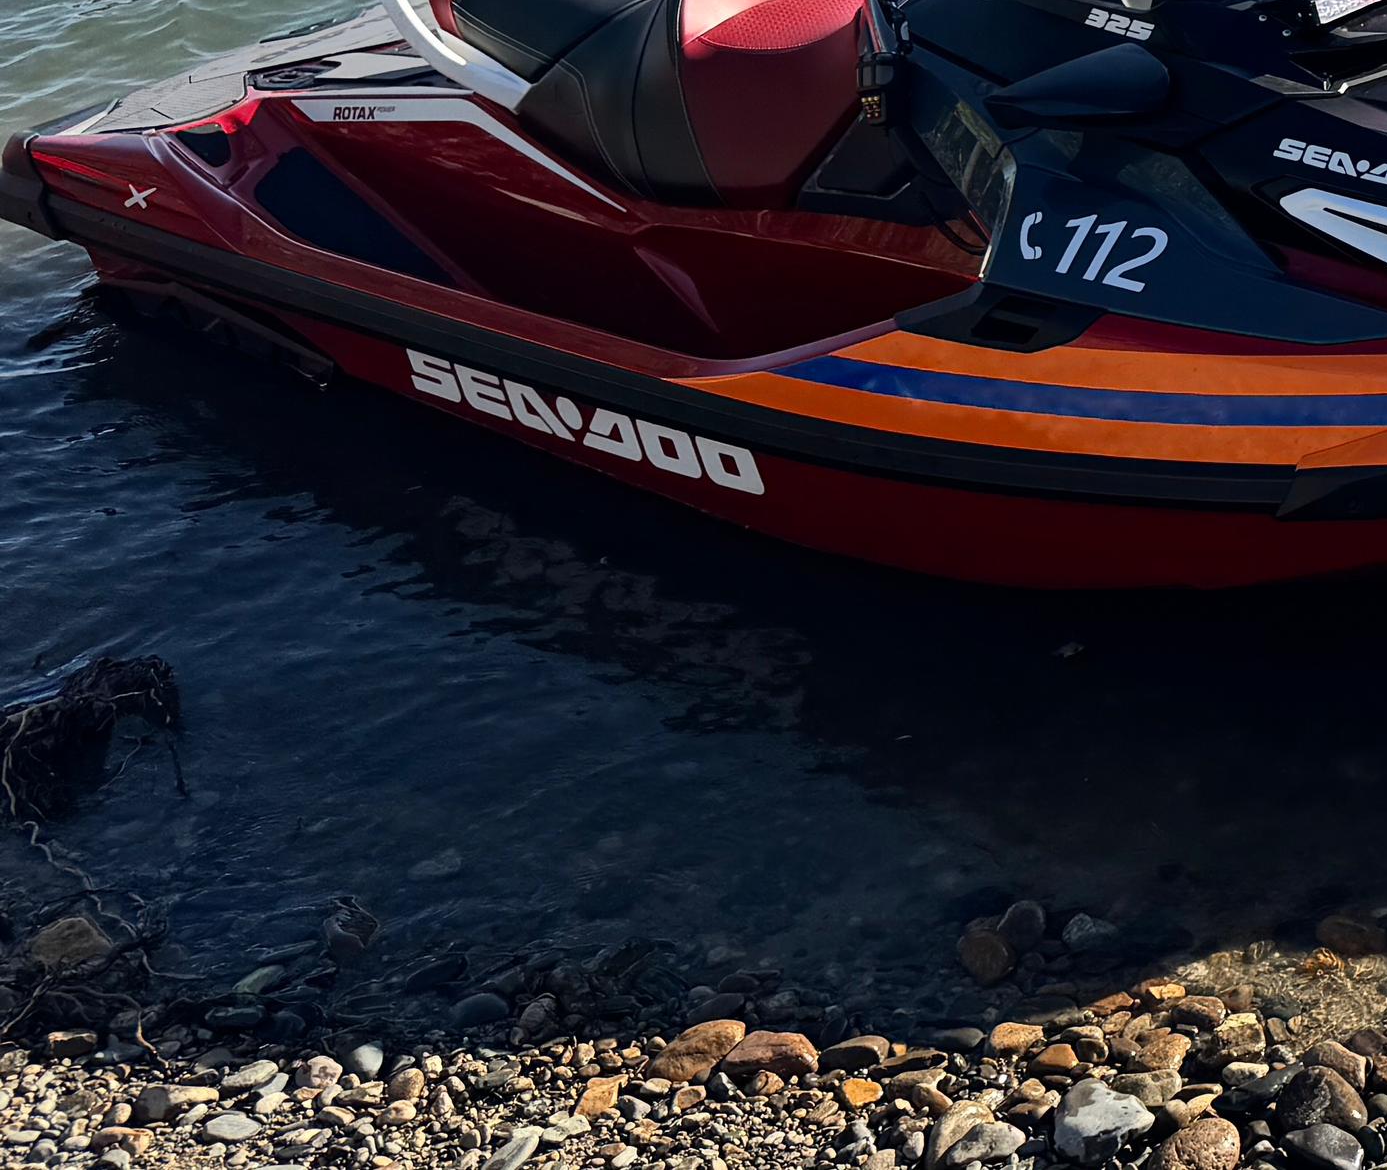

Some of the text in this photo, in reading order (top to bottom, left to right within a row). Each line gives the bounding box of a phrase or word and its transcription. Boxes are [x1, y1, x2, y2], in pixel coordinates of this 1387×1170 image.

[1084, 7, 1156, 41] 325
[332, 106, 377, 121] ROTAX
[1055, 214, 1169, 293] 112
